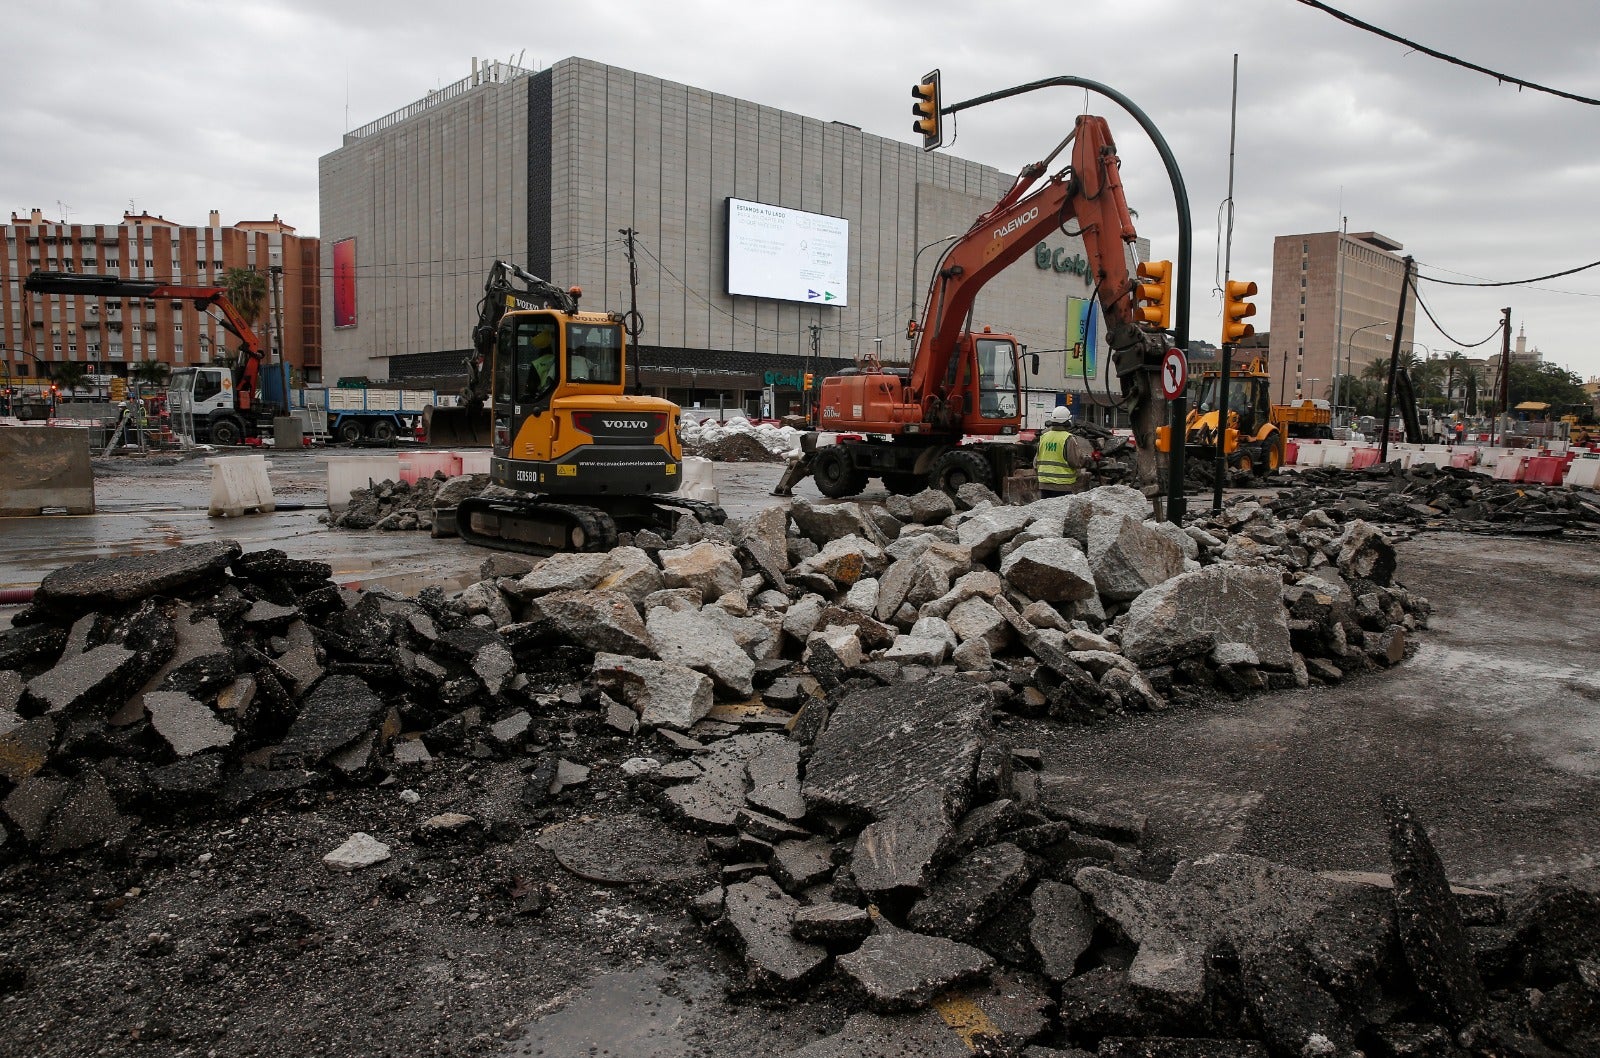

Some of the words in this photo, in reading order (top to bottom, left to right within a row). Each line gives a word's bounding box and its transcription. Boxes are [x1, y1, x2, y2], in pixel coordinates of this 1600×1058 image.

[736, 204, 760, 214] ESTAMOS
[772, 211, 786, 219] LADO
[993, 206, 1039, 240] DAEWOO
[515, 298, 539, 311] VOLVO
[573, 315, 608, 323] VOLVO
[601, 419, 648, 429] VOLVO
[516, 470, 537, 482] ECR58D
